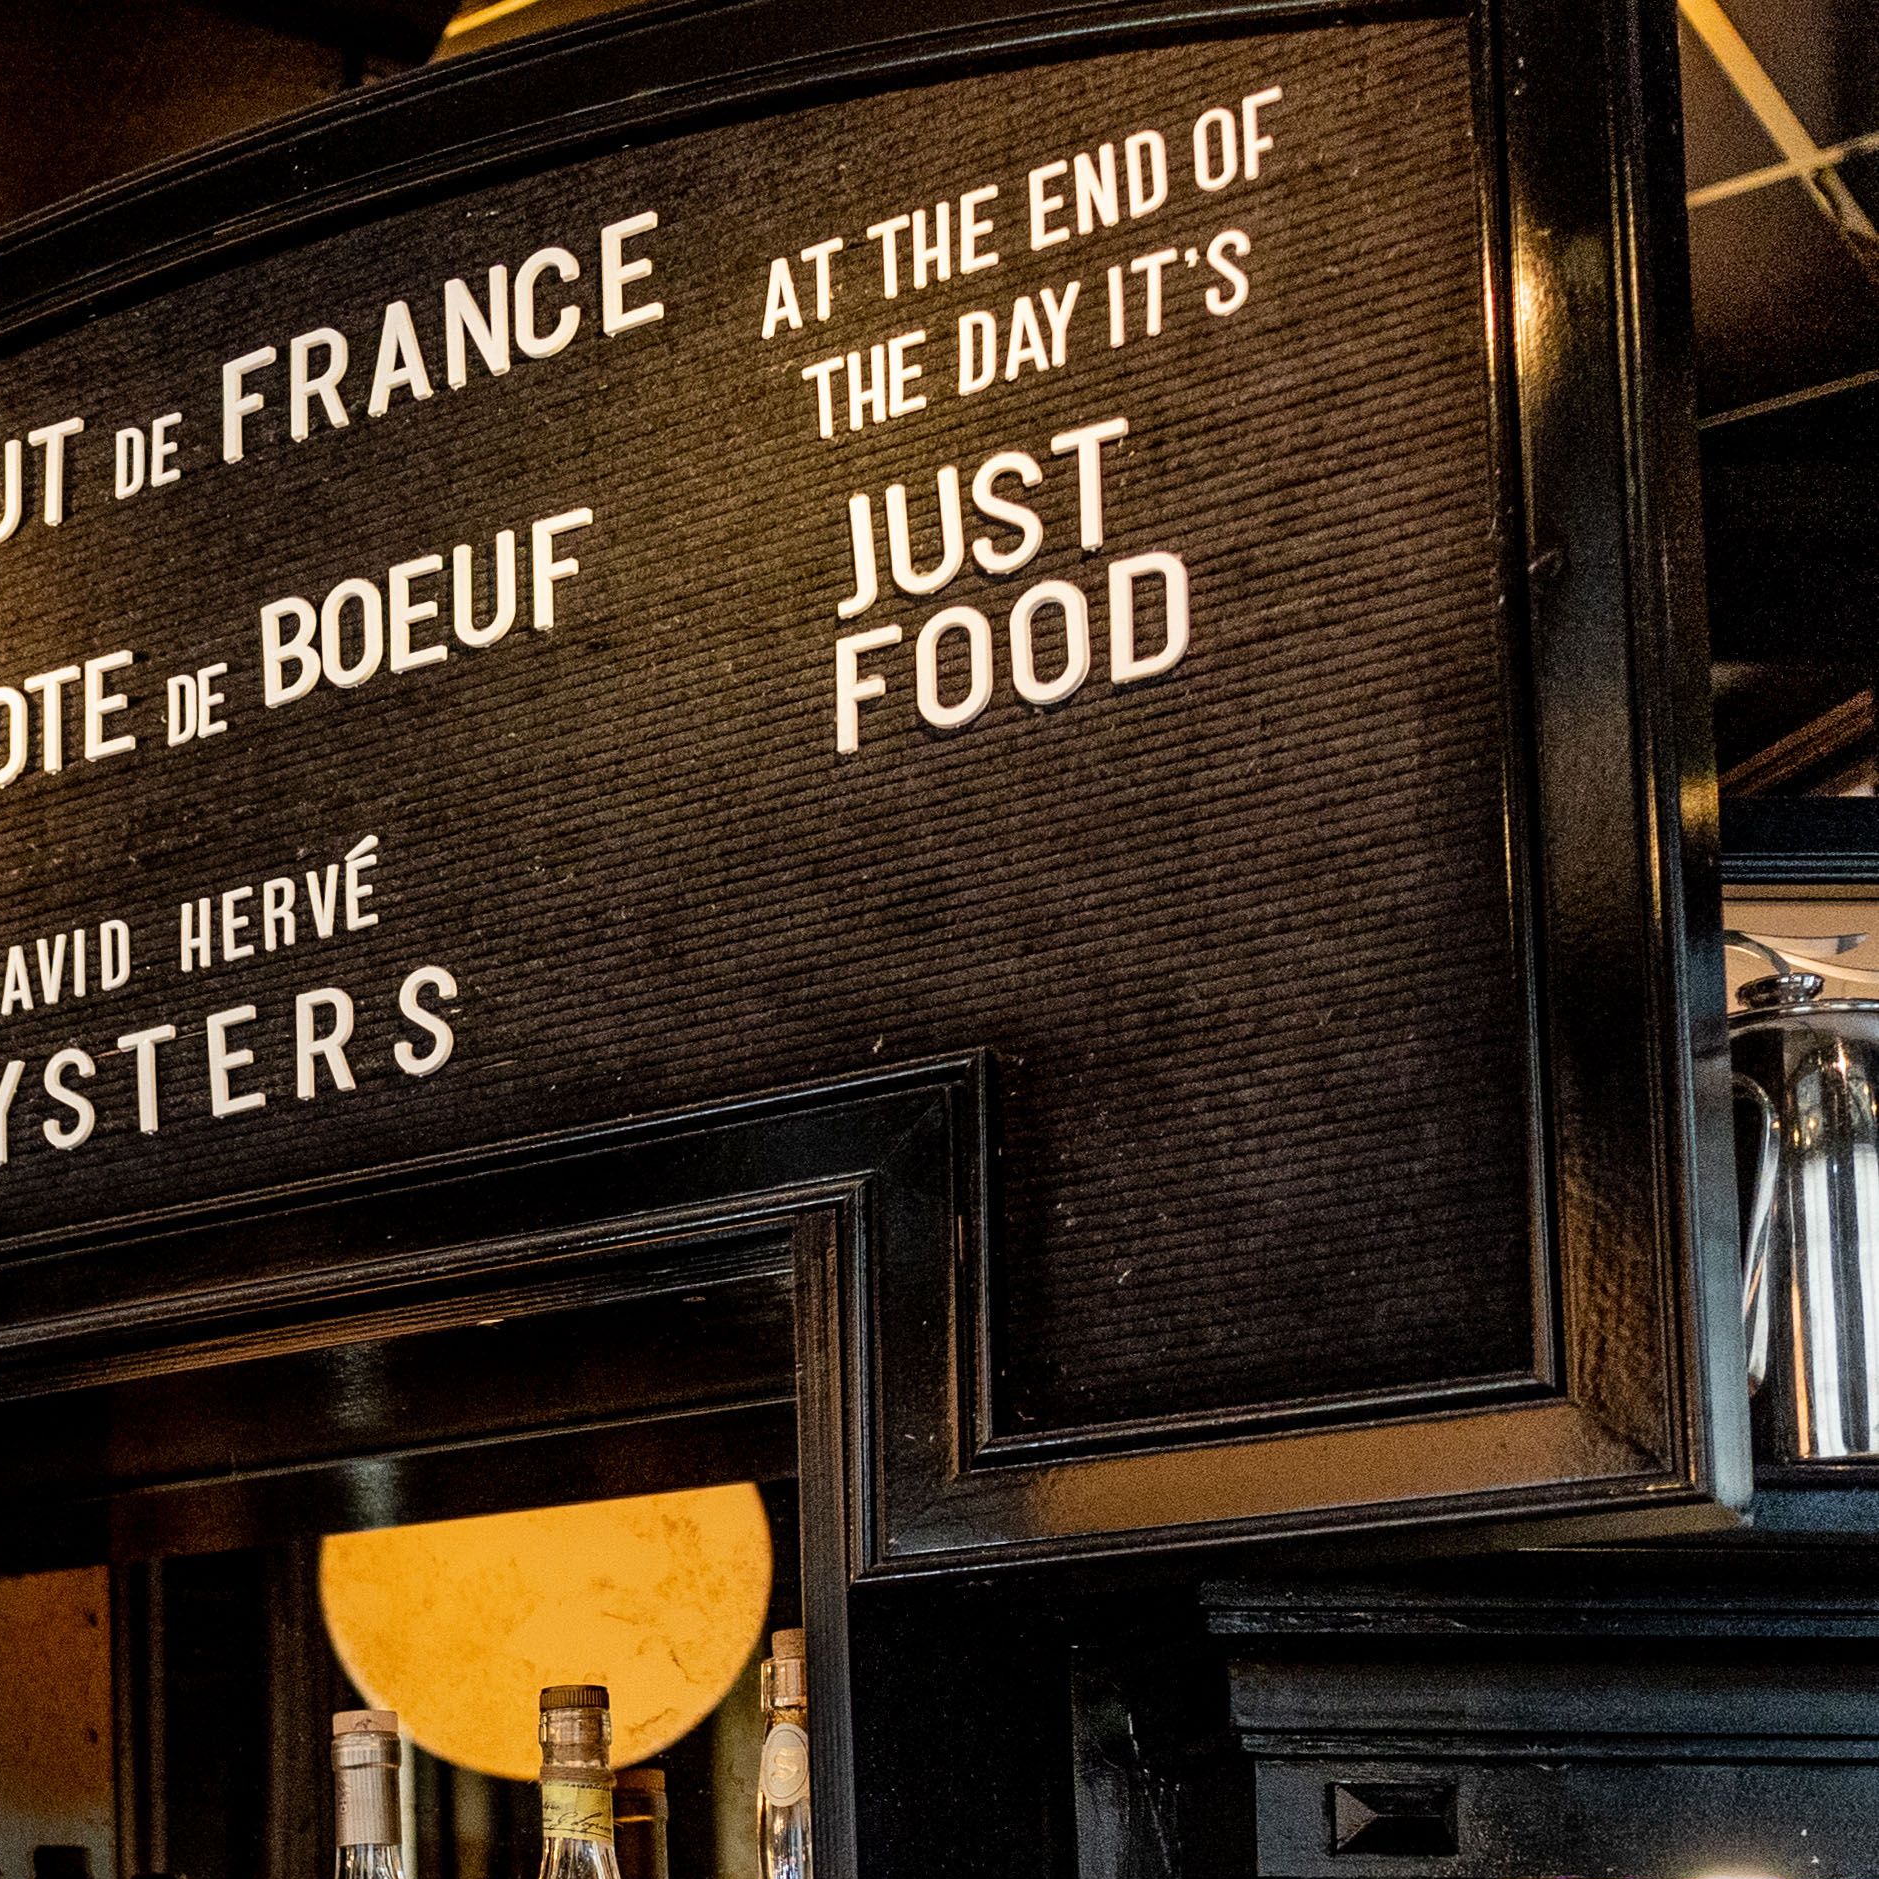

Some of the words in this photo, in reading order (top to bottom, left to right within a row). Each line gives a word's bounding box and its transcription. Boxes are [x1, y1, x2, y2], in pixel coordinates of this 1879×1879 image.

[760, 237, 845, 341] AT
[866, 184, 1000, 301] THE
[1028, 129, 1169, 253] END
[1192, 85, 1284, 193] OF
[114, 411, 183, 501] DE
[221, 209, 666, 467] FRANCE
[800, 329, 929, 440] THE
[958, 280, 1082, 397] DAY
[836, 416, 1131, 621] JUST
[166, 661, 230, 748] DE
[259, 506, 596, 709] BOEUF
[834, 550, 1192, 756] FOOD
[179, 834, 380, 974] HERVÉ
